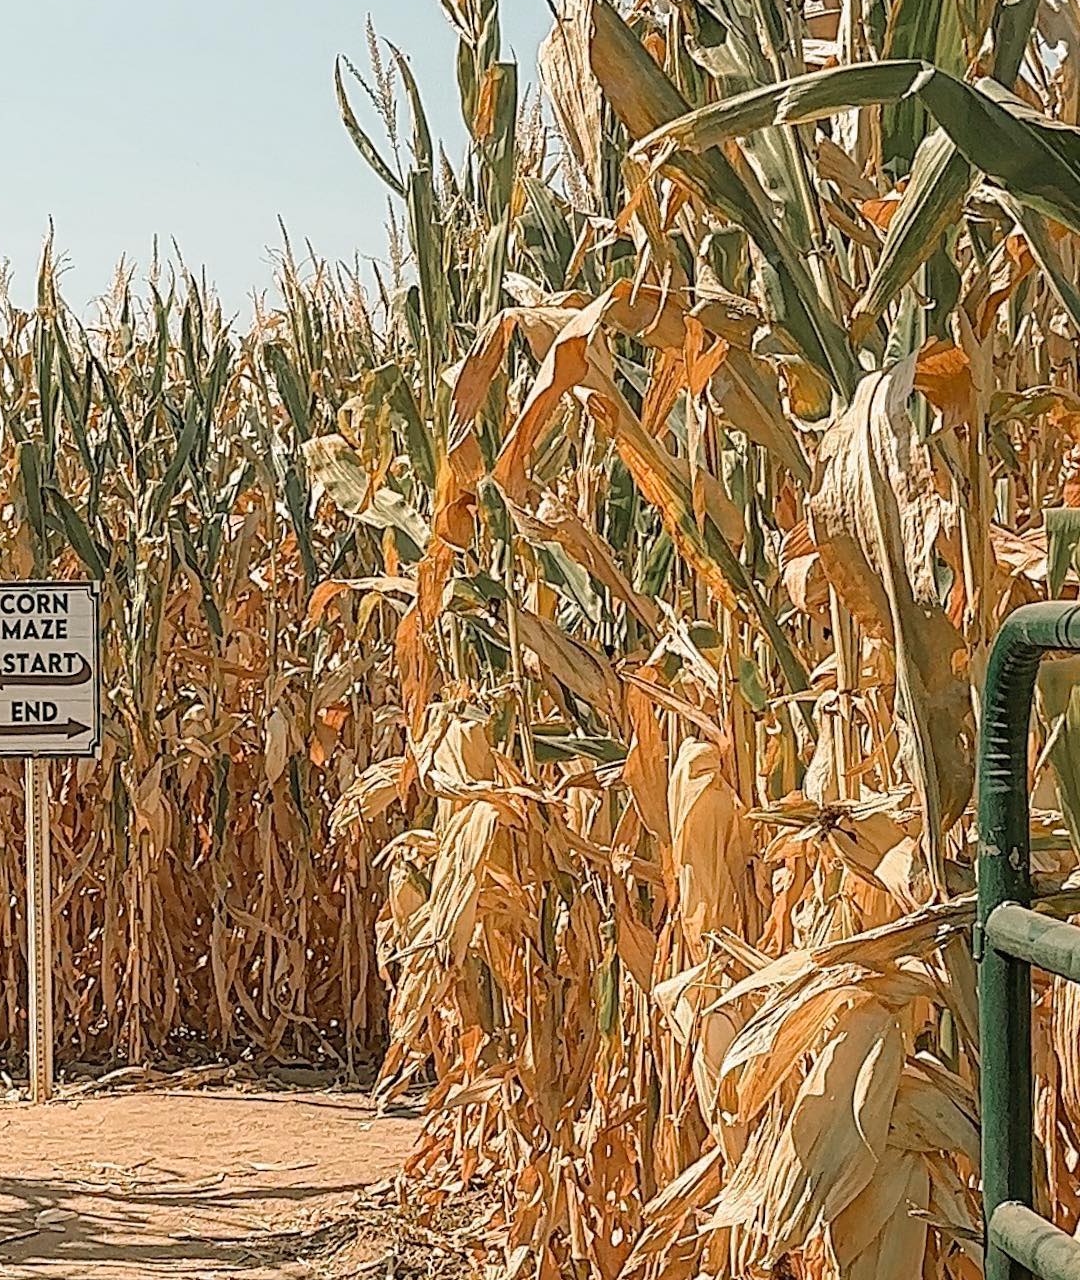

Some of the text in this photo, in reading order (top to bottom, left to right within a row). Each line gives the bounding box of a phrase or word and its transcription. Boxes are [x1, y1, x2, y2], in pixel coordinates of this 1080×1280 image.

[0, 593, 68, 614] CORN
[1, 619, 68, 640] MAZE
[2, 652, 76, 673] START
[11, 701, 58, 722] END
